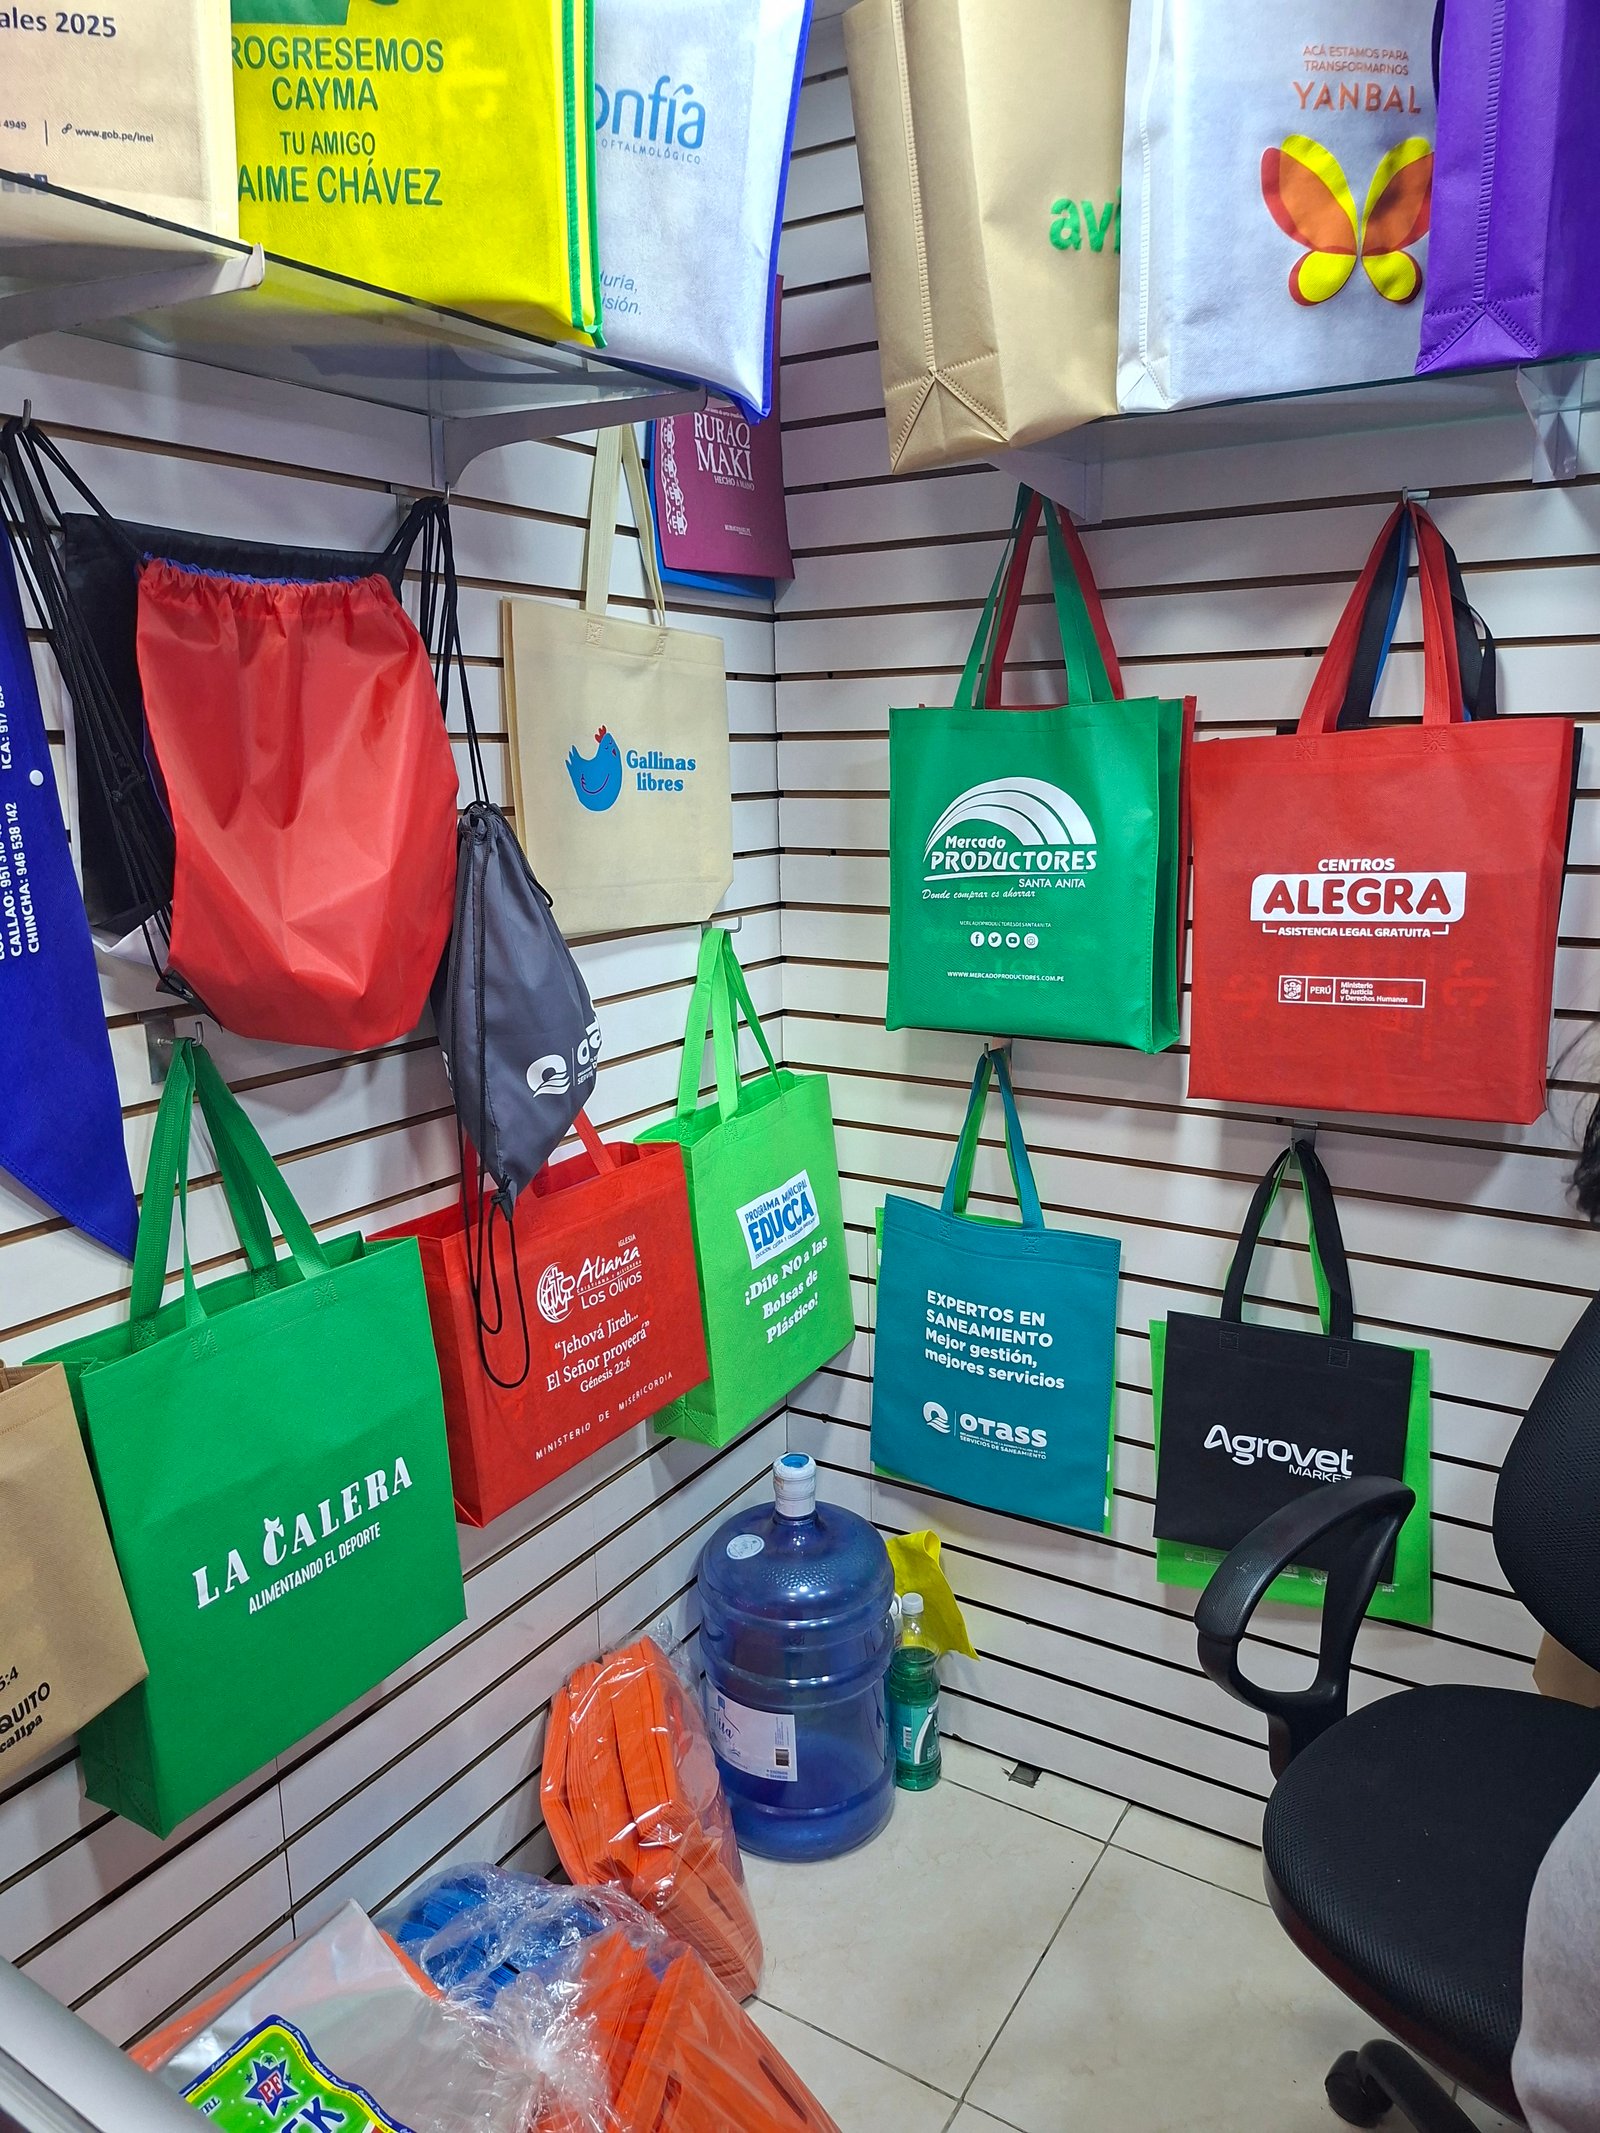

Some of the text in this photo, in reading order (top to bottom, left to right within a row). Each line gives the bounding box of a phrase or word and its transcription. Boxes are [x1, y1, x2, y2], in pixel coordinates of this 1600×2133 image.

[56, 12, 117, 37] 2025
[1303, 44, 1409, 61] ACÁ ESTAMOS PARA
[1304, 60, 1409, 76] TRANSFORMARNOS
[272, 76, 378, 111] CAYMA
[1293, 81, 1422, 114] YANBAL
[75, 128, 154, 143] www.gob.pe/inei
[280, 131, 376, 156] TU AMIGO
[601, 138, 701, 165] OFTALMOLÓGICO
[239, 158, 443, 206] AIME CHÁVEZ
[694, 411, 751, 450] RURAQ
[694, 439, 754, 481] MAKI
[0, 736, 12, 769] ICA:
[626, 750, 697, 771] Gallinas
[636, 772, 684, 792] libres
[945, 835, 1006, 849] Mercado
[5, 802, 40, 953] CHINCHA: 946 538 142
[930, 850, 1098, 872] PRODUCTORES
[1317, 857, 1395, 872] CENTROS
[921, 886, 1036, 901] Donde comprar es ahorrar
[1018, 878, 1086, 889] SANTA ANITA
[1262, 877, 1452, 916] ALEGRA
[3, 889, 22, 957] CALLAO:
[1277, 927, 1431, 938] ASISTENCIA LEGAL GRATUITA
[1310, 984, 1332, 995] PERÚ
[1345, 994, 1375, 1002] Derechos
[1349, 988, 1374, 996] Justicia
[748, 1191, 815, 1253] EDUCCA
[617, 1233, 637, 1248] IGLESIA
[577, 1246, 641, 1289] Alianza
[609, 1270, 643, 1297] Olivos
[744, 1273, 779, 1306] ¡Dile
[781, 1255, 802, 1280] NO
[803, 1250, 810, 1264] a
[811, 1237, 828, 1257] las
[762, 1269, 818, 1320] Bolsas de
[927, 1289, 1045, 1327] EXPERTOS EN
[766, 1291, 819, 1344] Plástico!
[926, 1309, 1054, 1348] SANEAMIENTO
[925, 1327, 1038, 1368] Mejor gestión,
[545, 1369, 561, 1392] El
[562, 1355, 601, 1383] Señor
[580, 1356, 631, 1393] Génesis 22:6
[925, 1347, 1065, 1390] mejores servicios
[535, 1371, 673, 1461] MINISTERIO DE MISERICORDIA
[960, 1435, 991, 1448] SERVICIOS
[991, 1443, 1000, 1451] DE
[1000, 1446, 1047, 1460] SANEAMIENTO
[1203, 1424, 1354, 1476] Agrovet
[192, 1456, 413, 1610] LA CALERA
[249, 1521, 381, 1615] ALIMENTANDO EL DEPORTE
[0, 1682, 51, 1735] QUITO
[0, 1714, 43, 1753] callpa
[258, 2070, 284, 2104] PF
